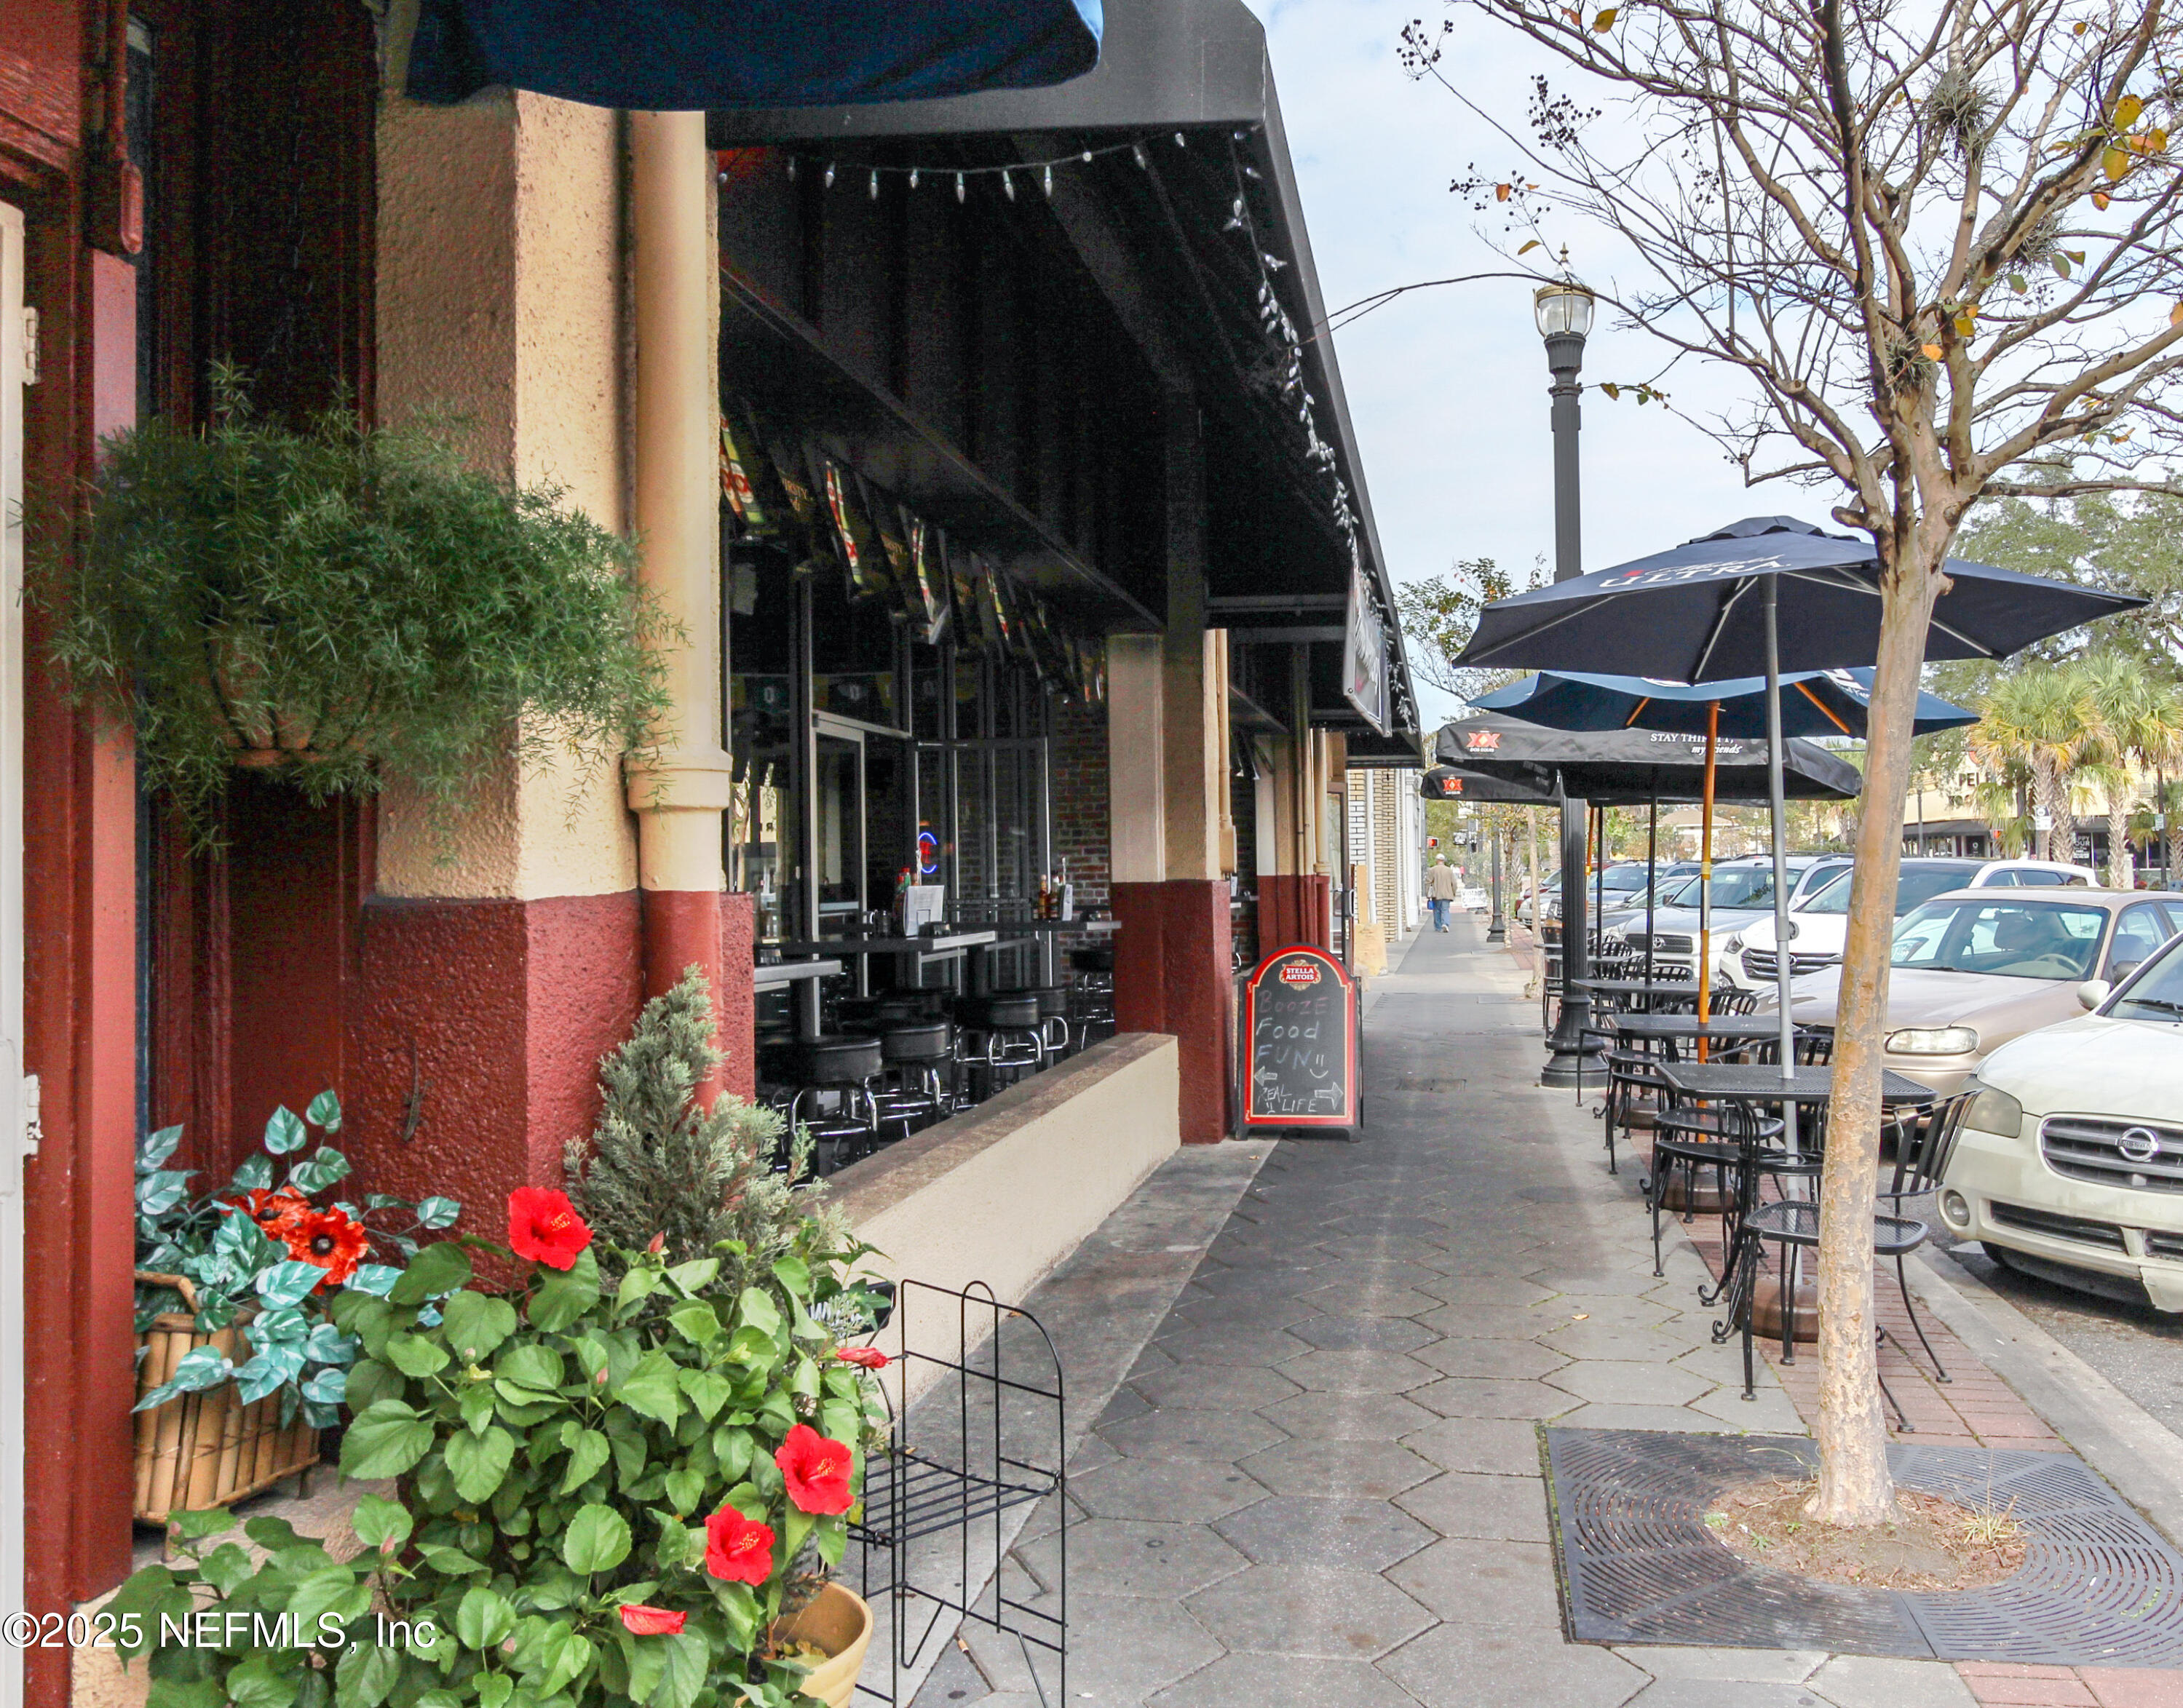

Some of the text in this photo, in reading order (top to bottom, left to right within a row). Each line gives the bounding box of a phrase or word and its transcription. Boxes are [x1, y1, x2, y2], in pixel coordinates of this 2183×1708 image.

[1650, 733, 1679, 742] STAY
[1691, 746, 1706, 756] my
[1282, 1098, 1318, 1113] LIFE
